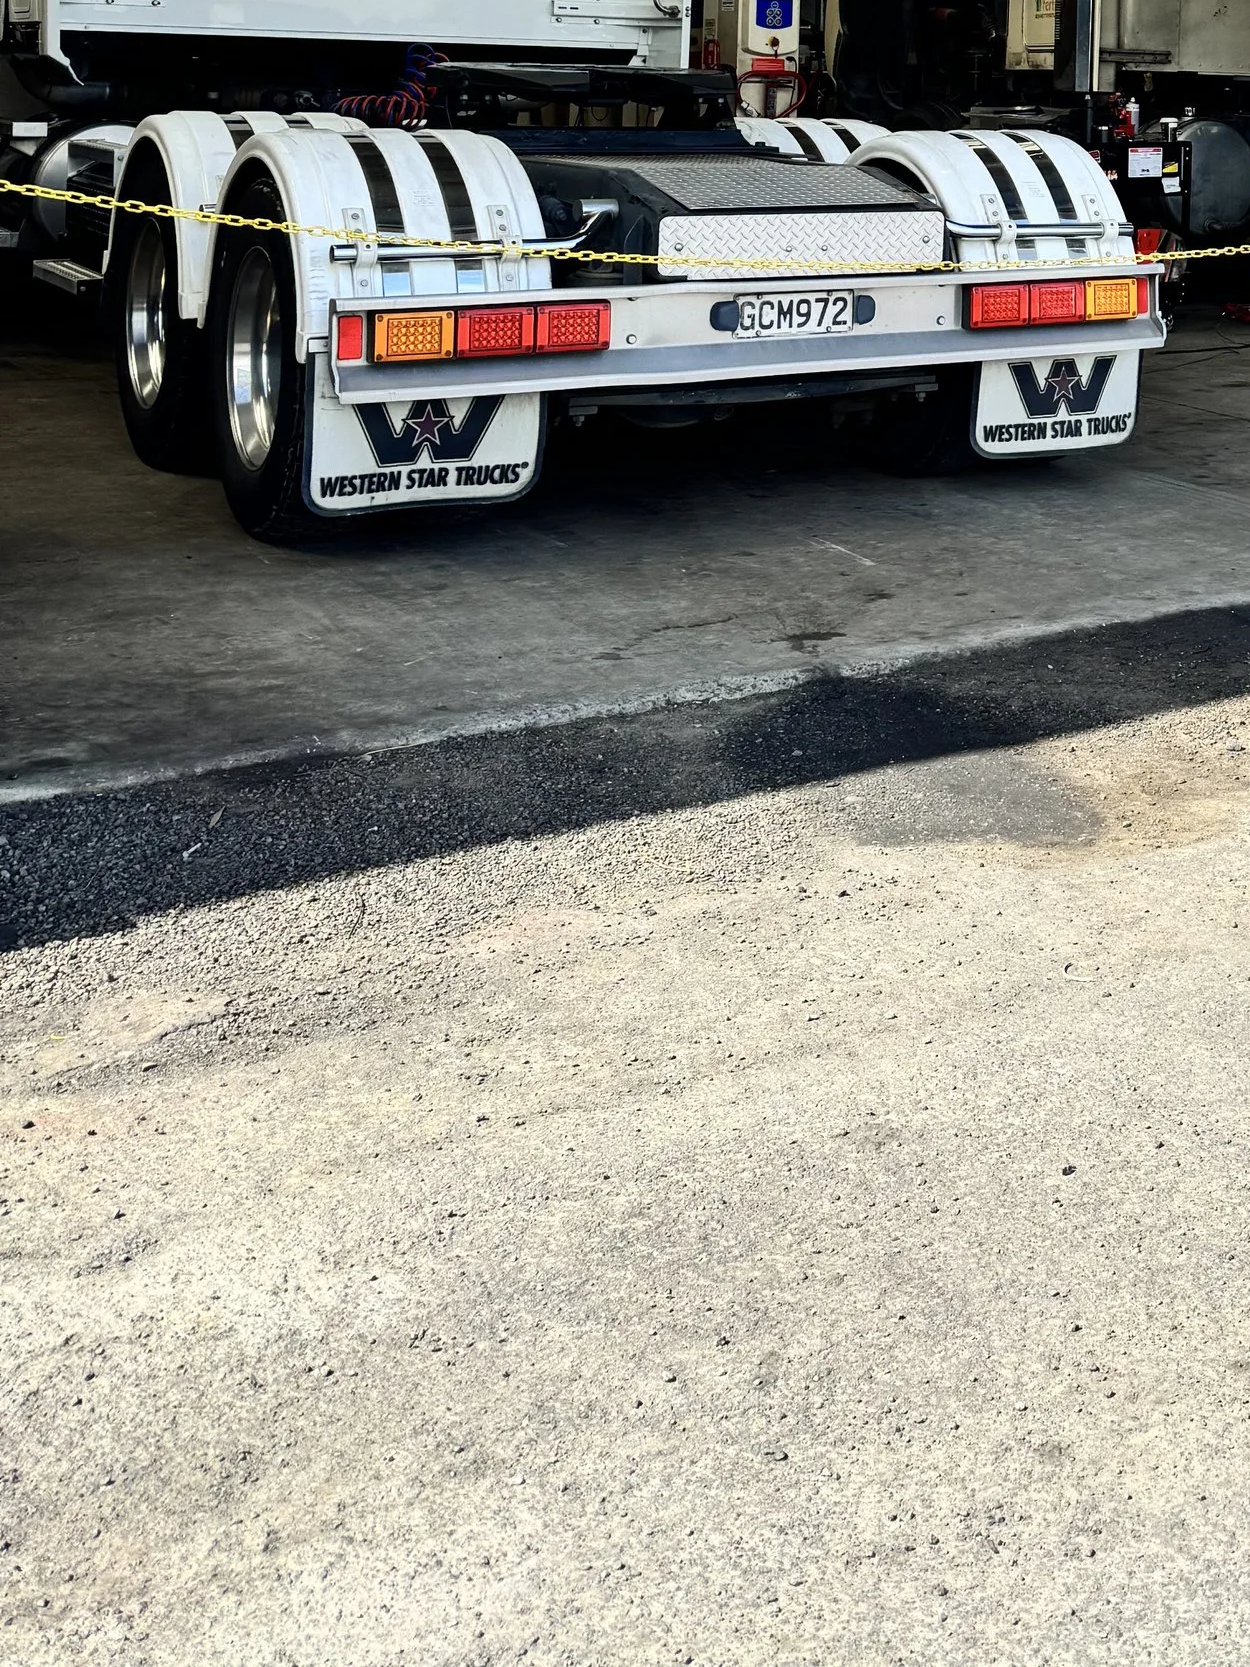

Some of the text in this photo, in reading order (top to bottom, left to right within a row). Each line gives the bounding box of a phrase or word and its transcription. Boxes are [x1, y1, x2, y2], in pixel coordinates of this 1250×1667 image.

[739, 296, 849, 331] GCM972
[982, 421, 1048, 443] WESTERN
[1050, 417, 1082, 440] STAR
[319, 470, 402, 499] WESTERN
[405, 466, 450, 490] STAR
